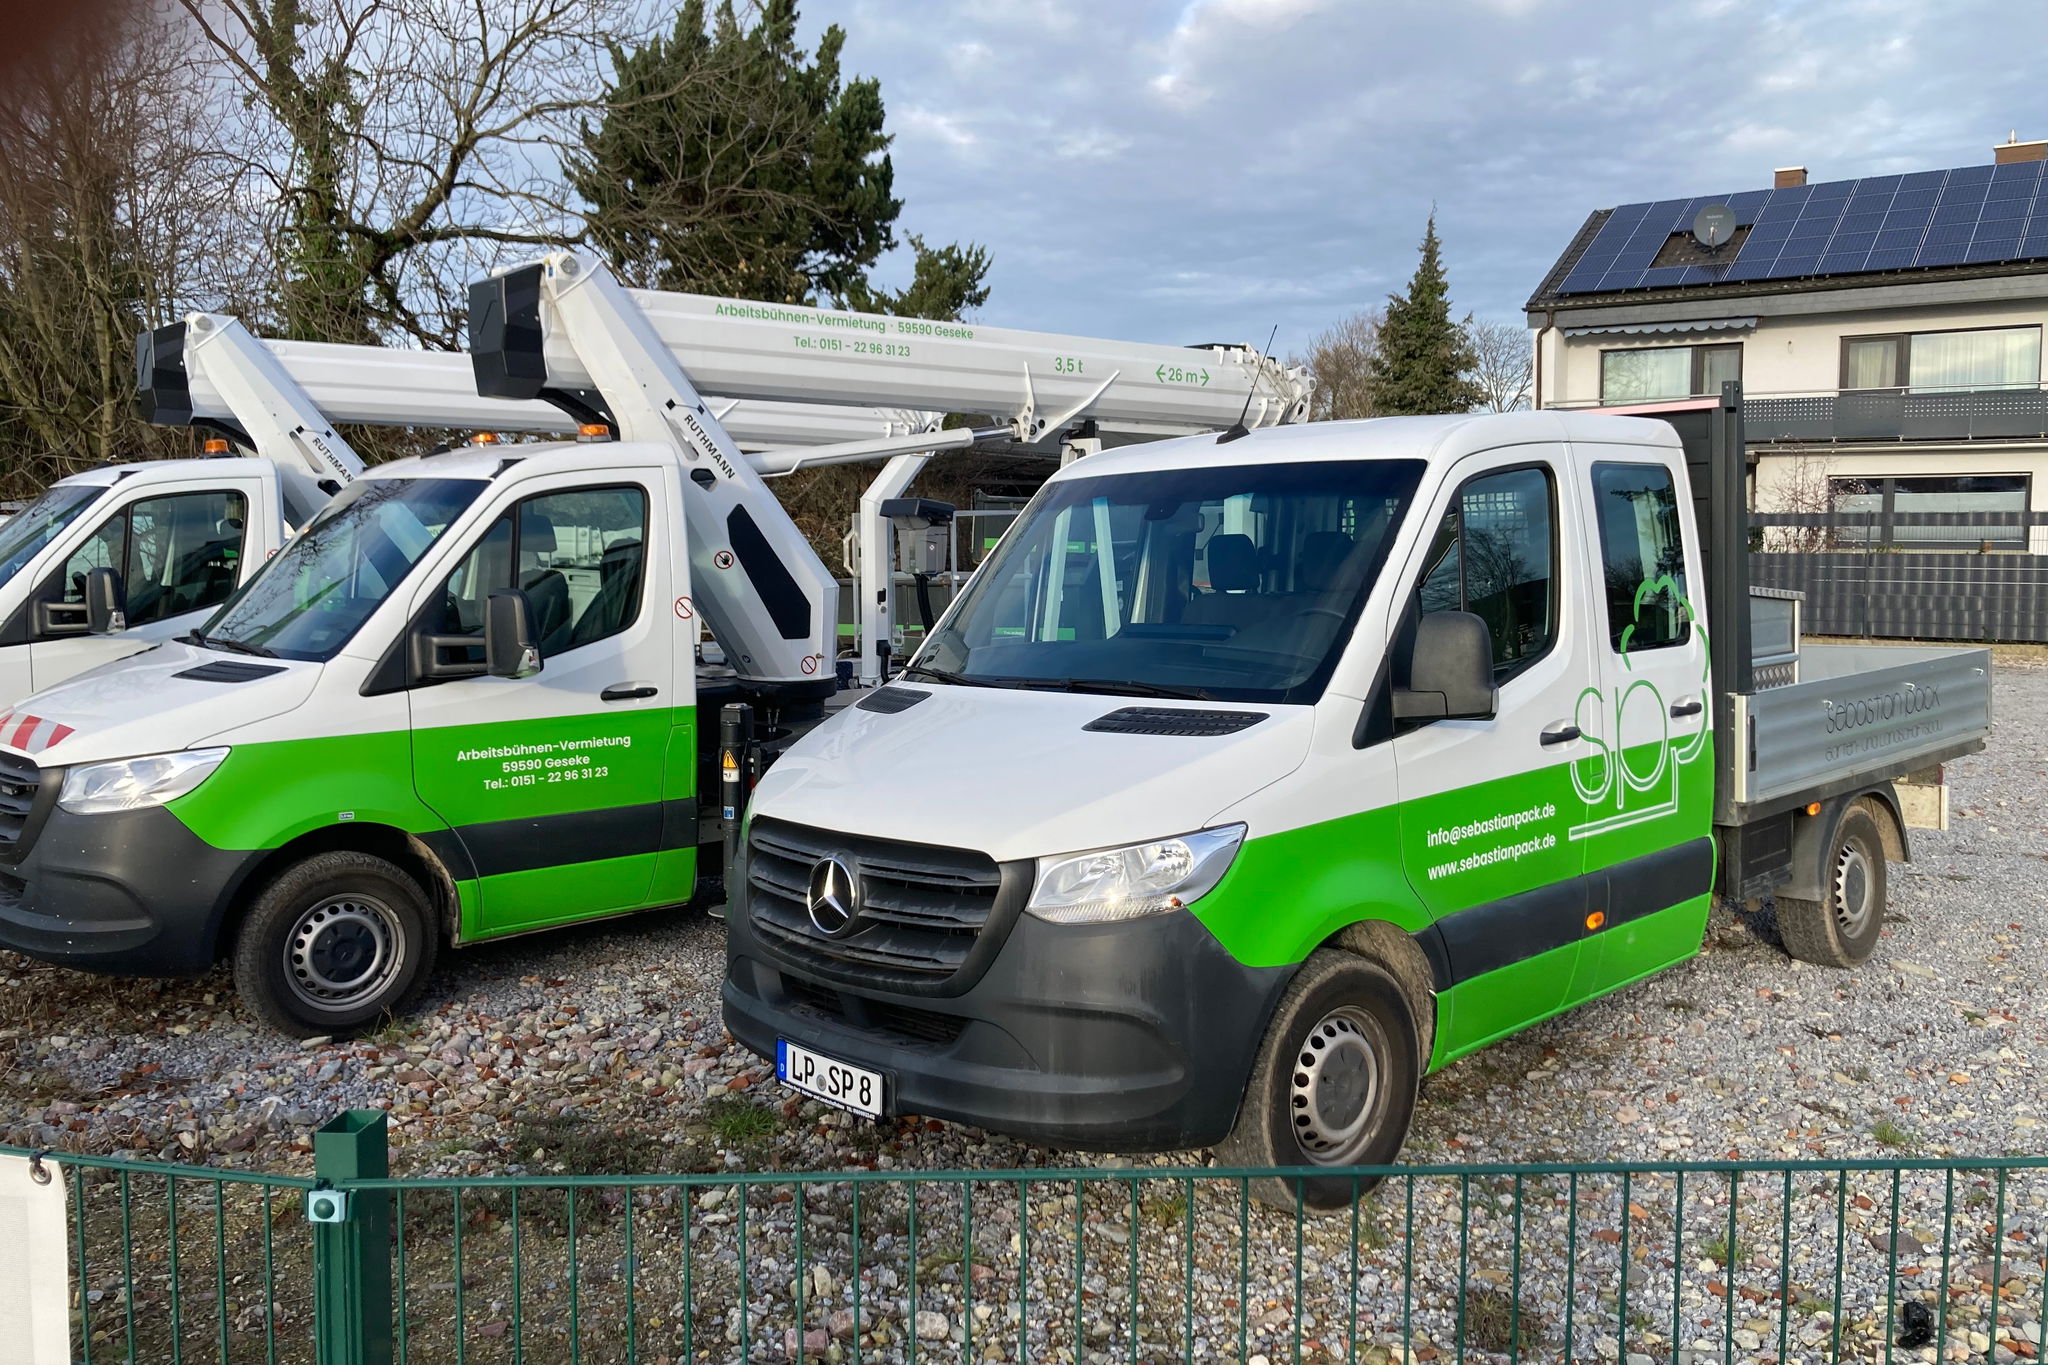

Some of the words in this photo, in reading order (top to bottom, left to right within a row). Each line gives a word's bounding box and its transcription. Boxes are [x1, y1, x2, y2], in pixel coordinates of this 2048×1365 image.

[715, 303, 886, 333] Arbeitsbühnen-Vermietung
[897, 321, 932, 336] 59590
[934, 325, 974, 339] Geseke
[793, 335, 817, 349] Tel.:
[819, 337, 842, 350] 0151
[854, 341, 867, 353] 22
[869, 343, 883, 355] 96
[885, 345, 895, 356] 31
[898, 346, 911, 357] 23
[1054, 357, 1075, 374] 3,5
[1078, 359, 1084, 373] t
[1168, 367, 1183, 382] 26
[1186, 371, 1198, 383] m
[684, 414, 736, 479] RUTHMANN
[457, 736, 631, 761] Arbeitsbühnen-Vermietung
[502, 758, 542, 773] 59590
[544, 754, 590, 769] Geseke
[484, 778, 508, 790] Tel.:
[511, 774, 535, 787] 0151
[547, 771, 562, 783] 22
[564, 769, 579, 781] 96
[581, 768, 593, 779] 31
[595, 766, 609, 777] 23
[1427, 802, 1557, 848] info@sebastianpack.de
[1427, 833, 1557, 880] www.sebastianpack.de
[792, 1050, 815, 1085] LP
[828, 1065, 854, 1099] SP
[859, 1075, 872, 1107] 8
